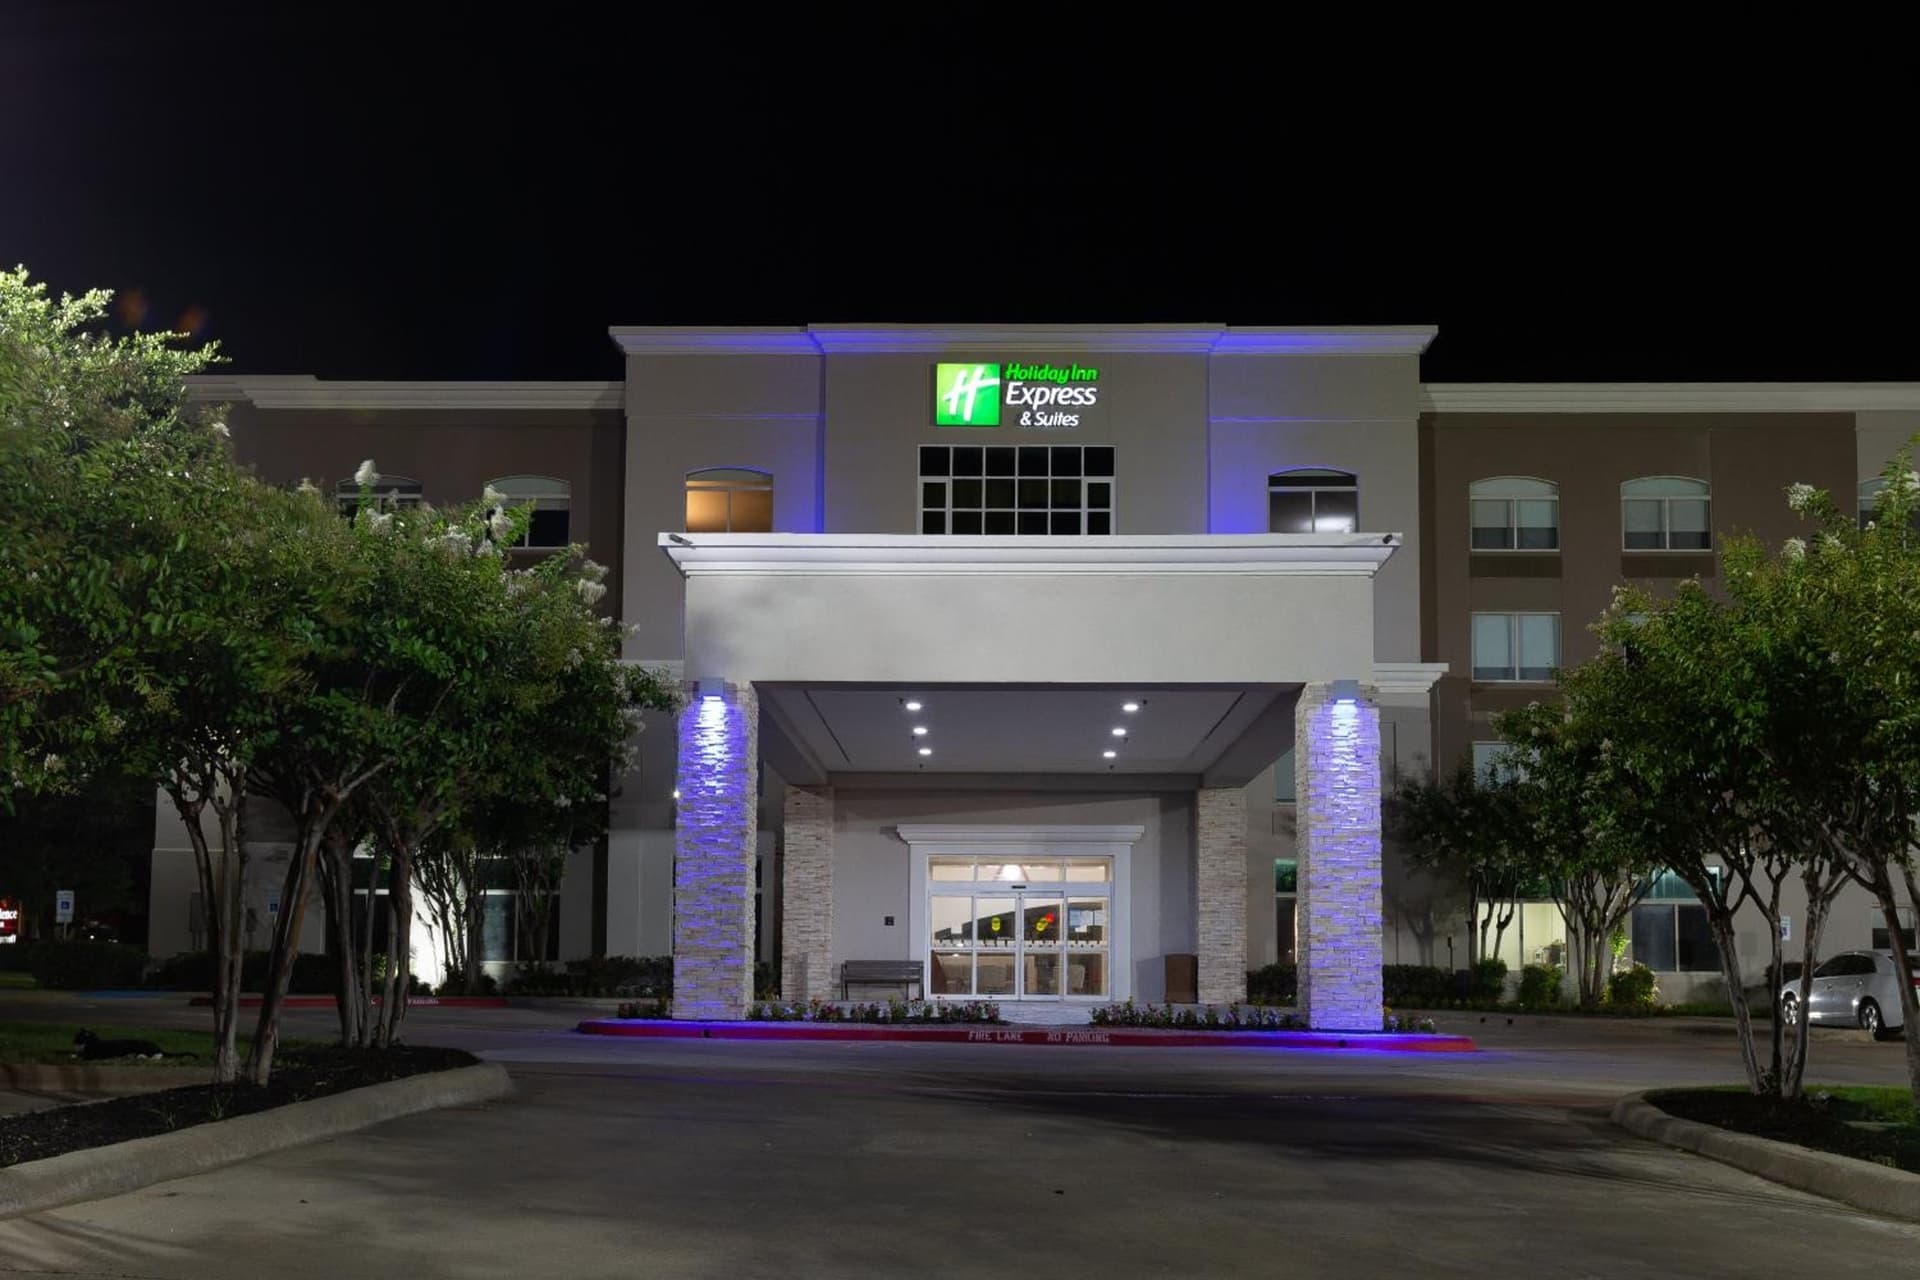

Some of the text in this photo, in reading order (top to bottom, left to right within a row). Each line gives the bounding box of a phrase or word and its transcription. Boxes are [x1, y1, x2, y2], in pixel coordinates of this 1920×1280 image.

[1005, 363, 1098, 383] Holiday Inn
[1006, 382, 1097, 410] Express
[1020, 411, 1079, 427] & Suites
[968, 1030, 1110, 1043] FIRE LANE NO PARKING
